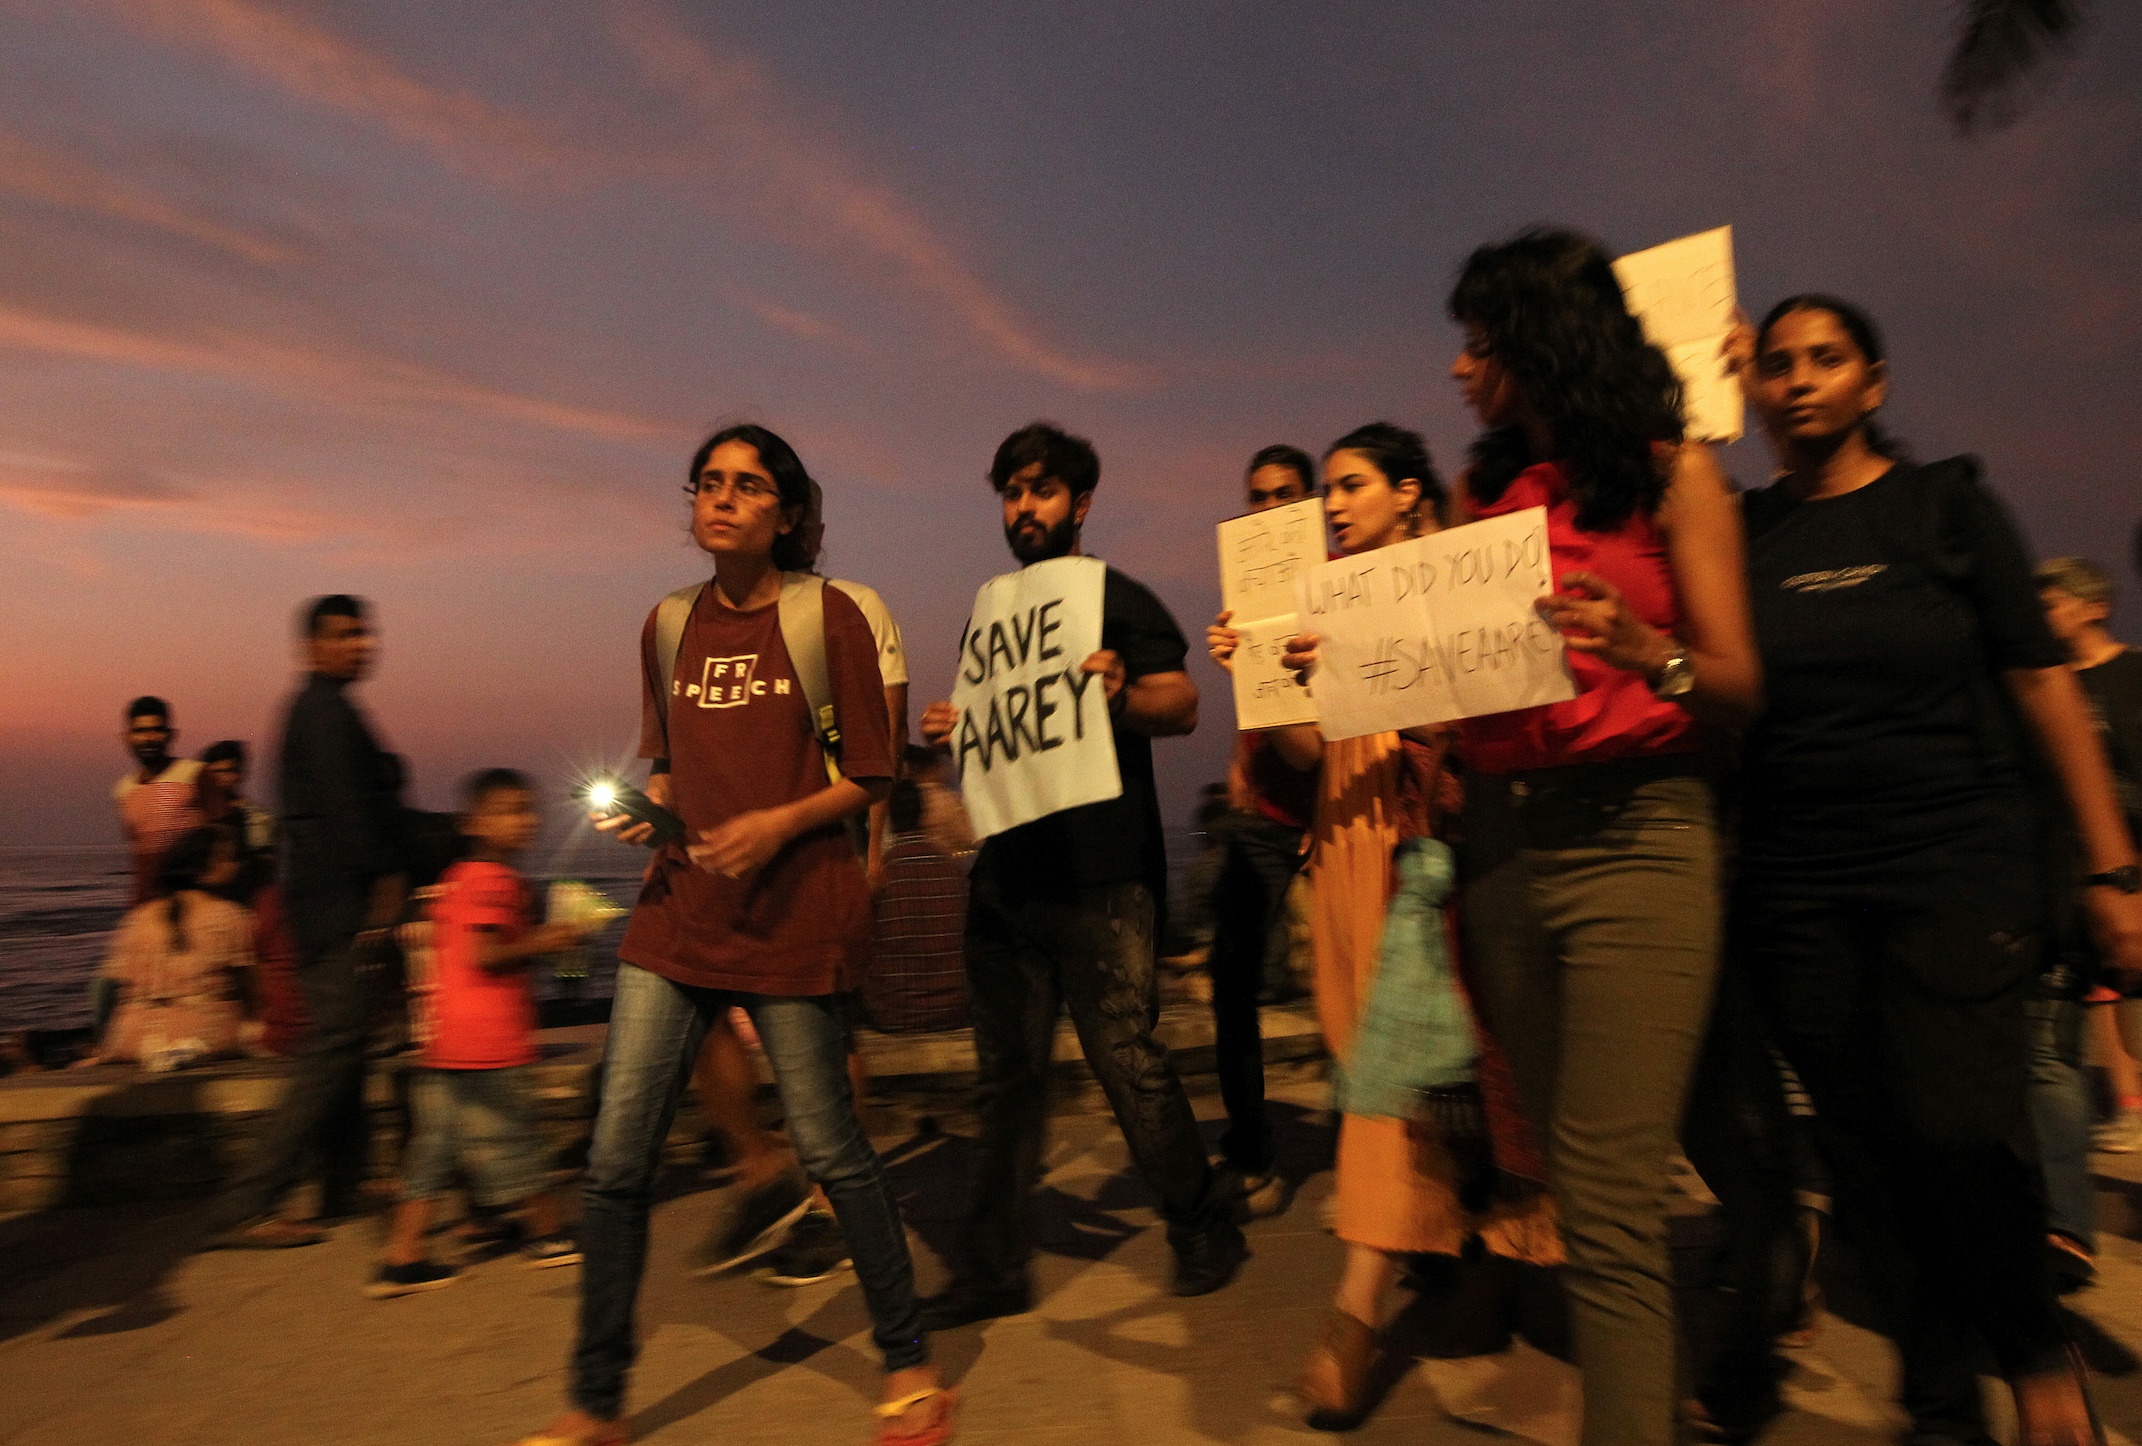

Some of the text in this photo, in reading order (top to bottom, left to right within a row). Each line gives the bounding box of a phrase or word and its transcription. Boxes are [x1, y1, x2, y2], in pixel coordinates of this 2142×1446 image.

[1304, 567, 1376, 615] WHAT
[1391, 562, 1438, 603] DID
[1442, 544, 1495, 592] YOU
[713, 662, 748, 679] FR
[963, 597, 1065, 685] SAVE
[672, 678, 792, 702] SPEECH
[958, 667, 1096, 773] AAREY
